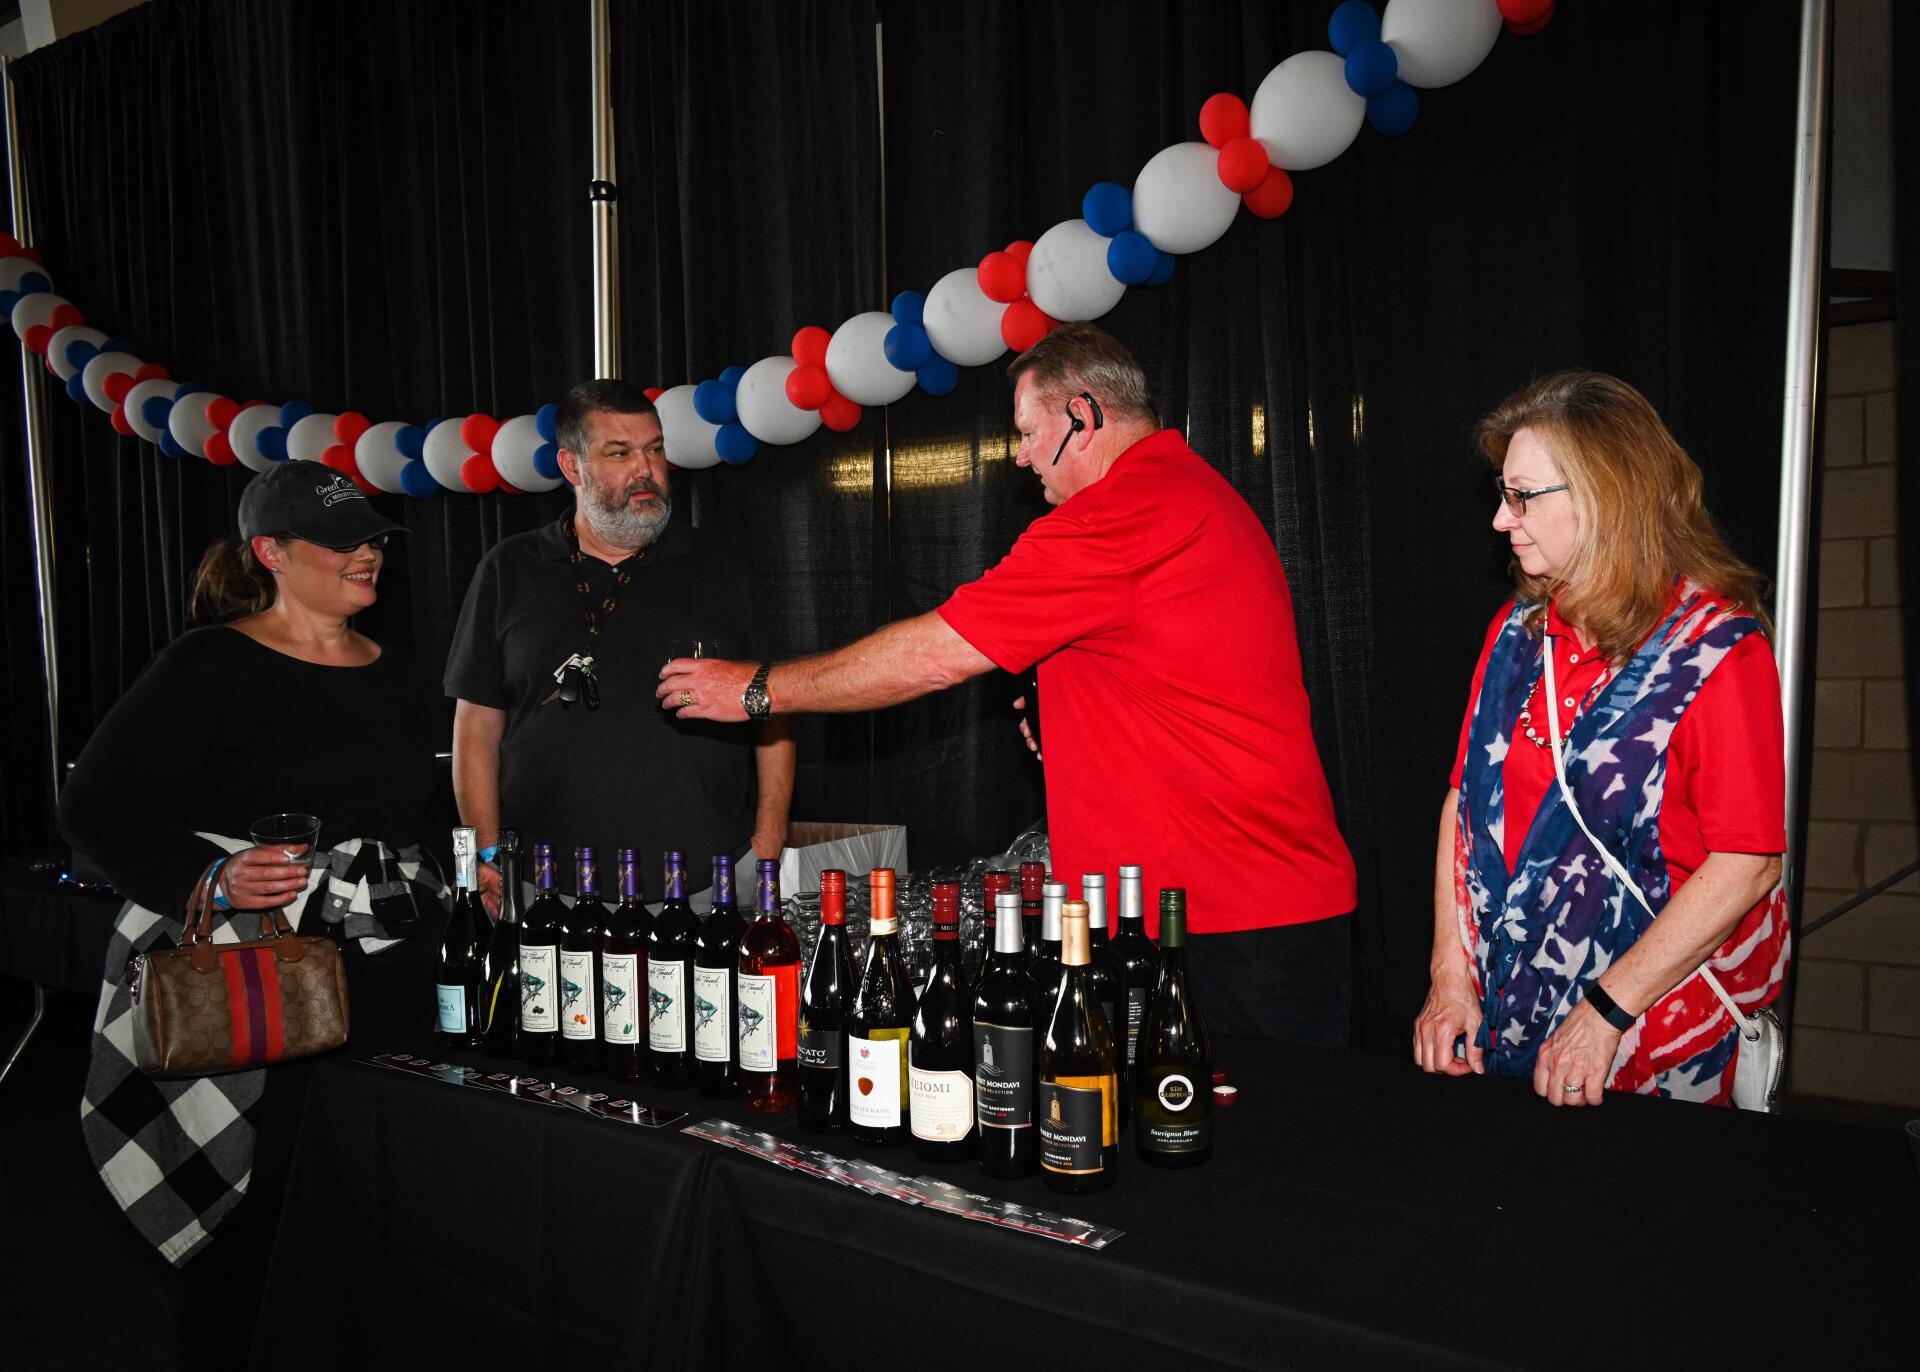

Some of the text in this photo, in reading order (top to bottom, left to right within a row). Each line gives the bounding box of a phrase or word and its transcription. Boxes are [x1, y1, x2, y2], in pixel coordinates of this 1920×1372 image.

[316, 480, 340, 496] Great
[986, 1079, 1020, 1089] MONDAVI
[1052, 1133, 1086, 1143] MONDAVI
[1150, 1128, 1200, 1138] Sauvignon Blanc
